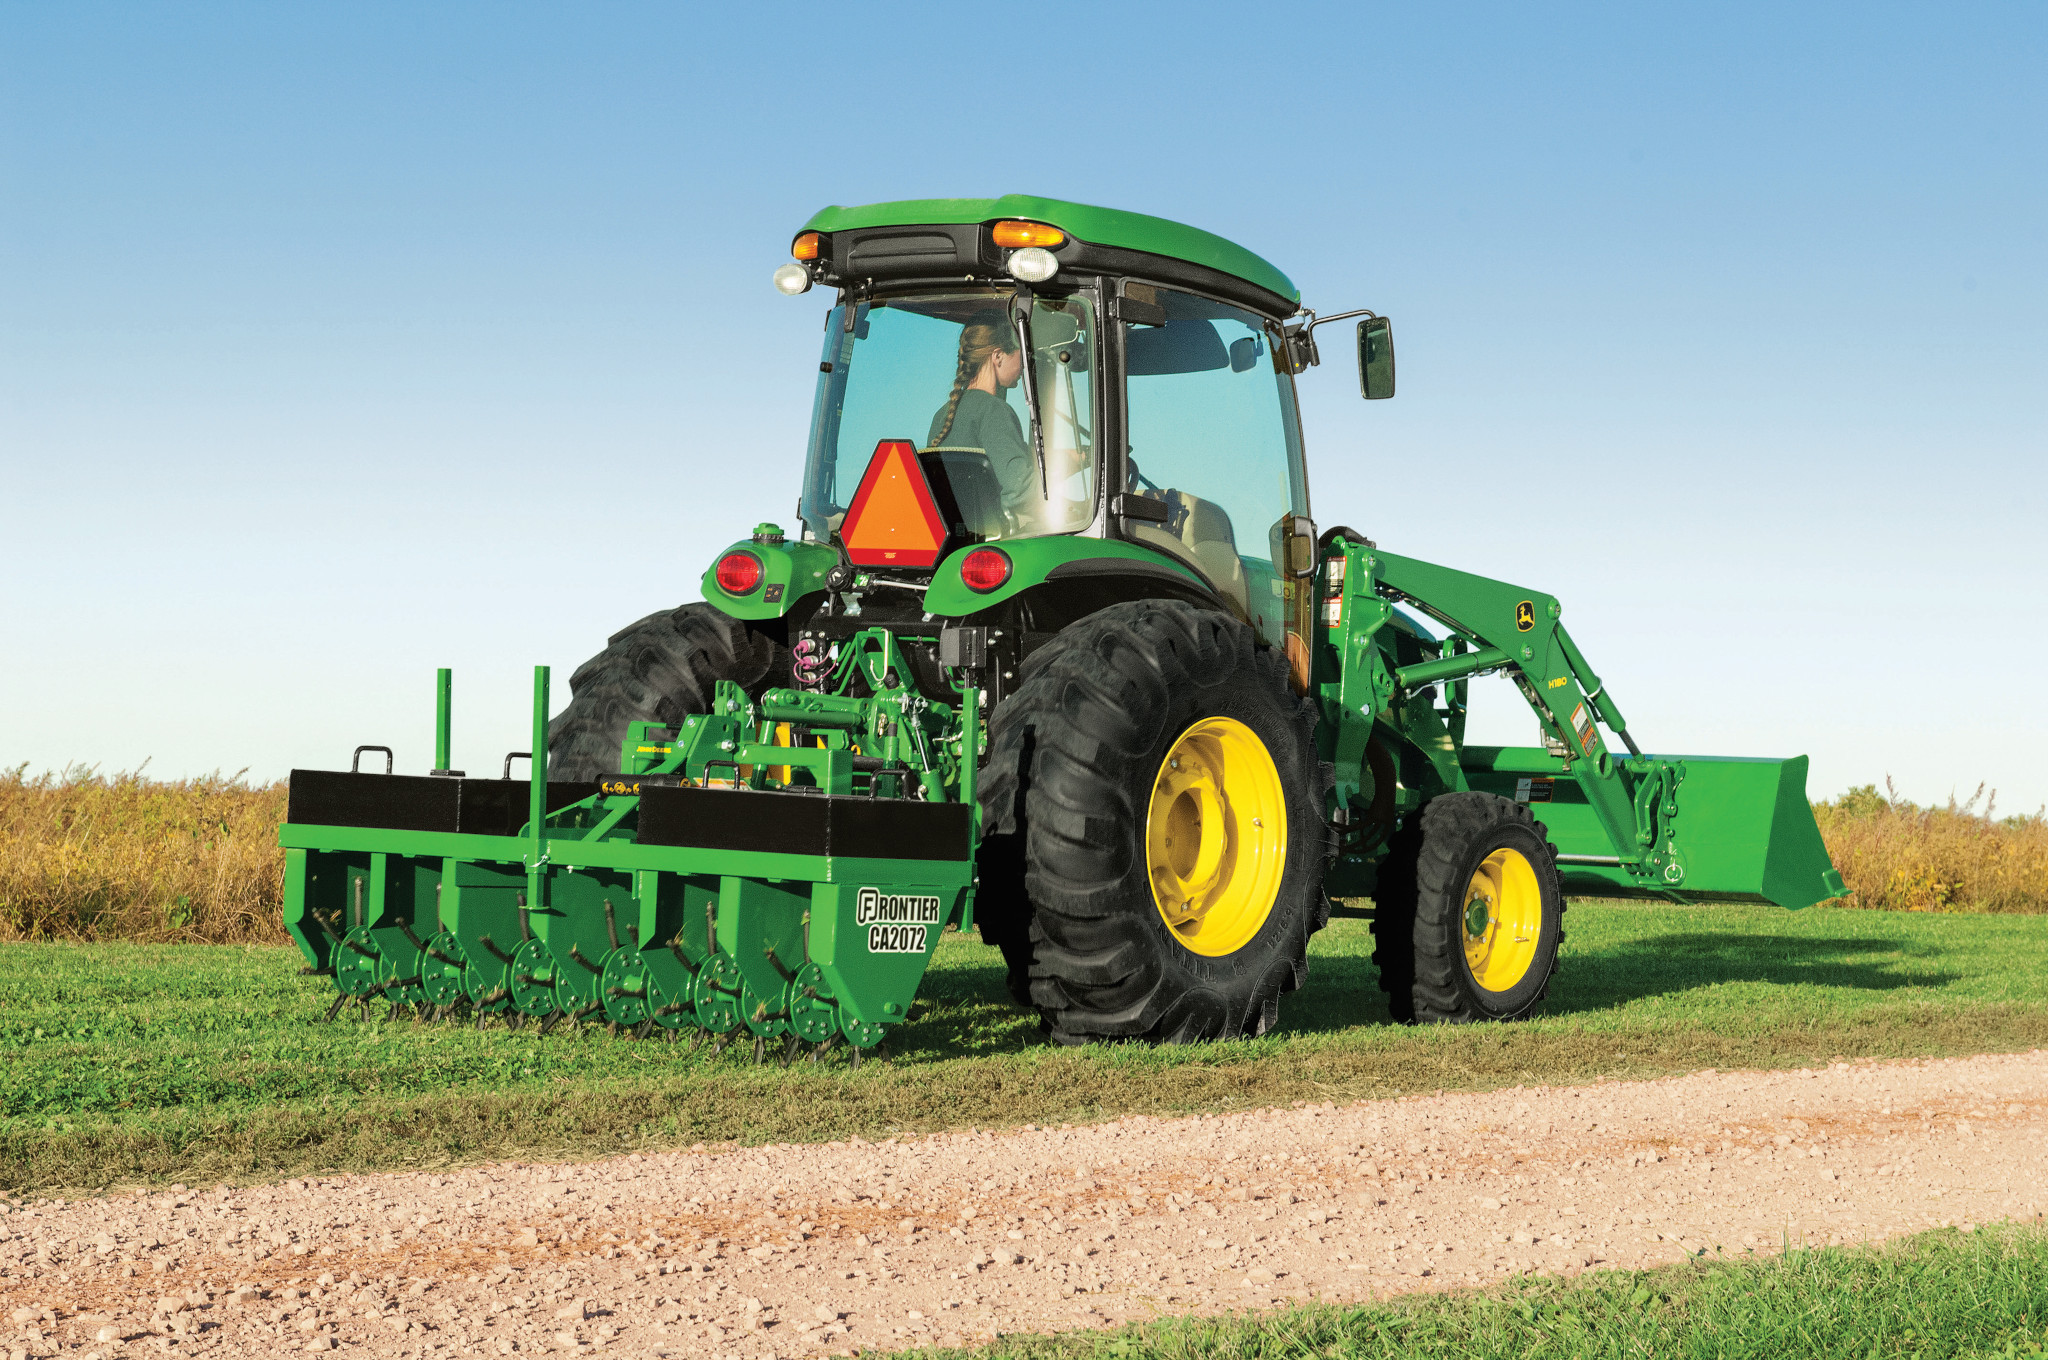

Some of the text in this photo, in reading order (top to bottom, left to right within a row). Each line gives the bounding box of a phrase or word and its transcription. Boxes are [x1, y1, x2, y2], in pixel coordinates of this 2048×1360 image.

[1548, 676, 1567, 690] H180
[858, 889, 939, 923] FRONTIER
[869, 926, 925, 951] CA2072
[1156, 922, 1219, 985] TITAN
